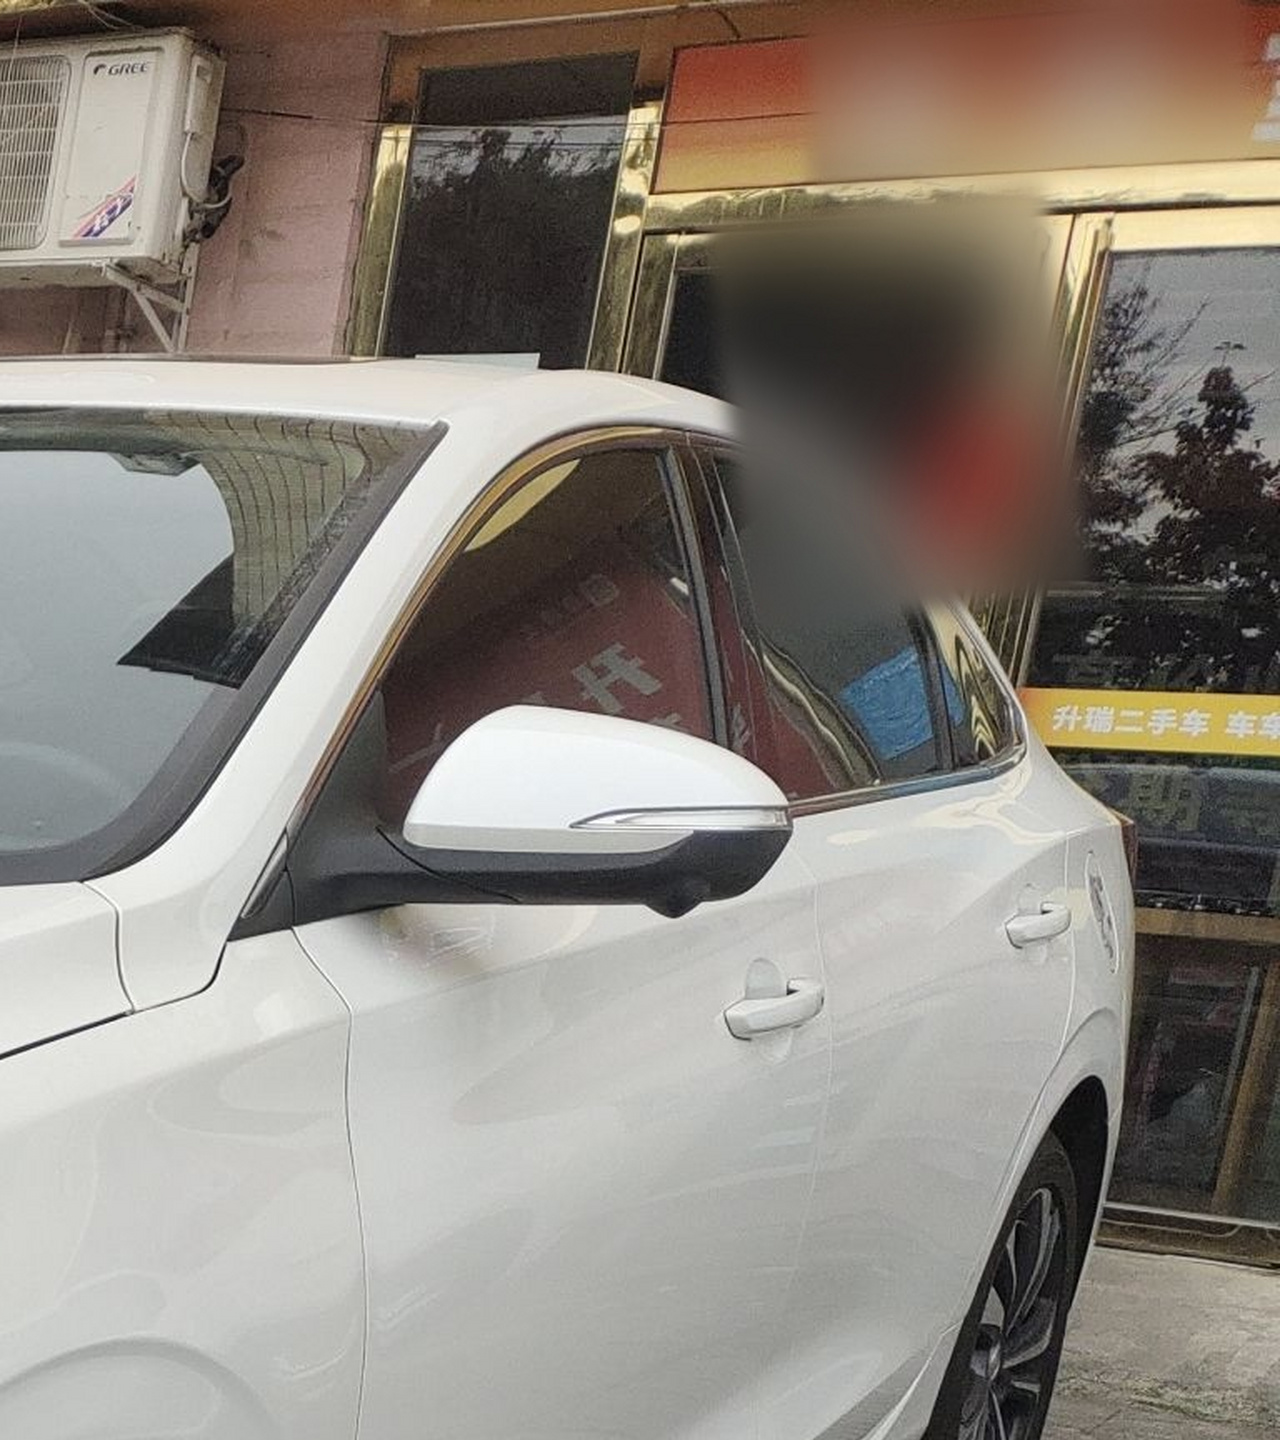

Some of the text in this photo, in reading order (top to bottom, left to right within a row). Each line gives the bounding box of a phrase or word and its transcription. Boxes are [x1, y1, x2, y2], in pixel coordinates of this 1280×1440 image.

[108, 63, 149, 75] GREE
[1052, 705, 1211, 736] 升瑞二手车
